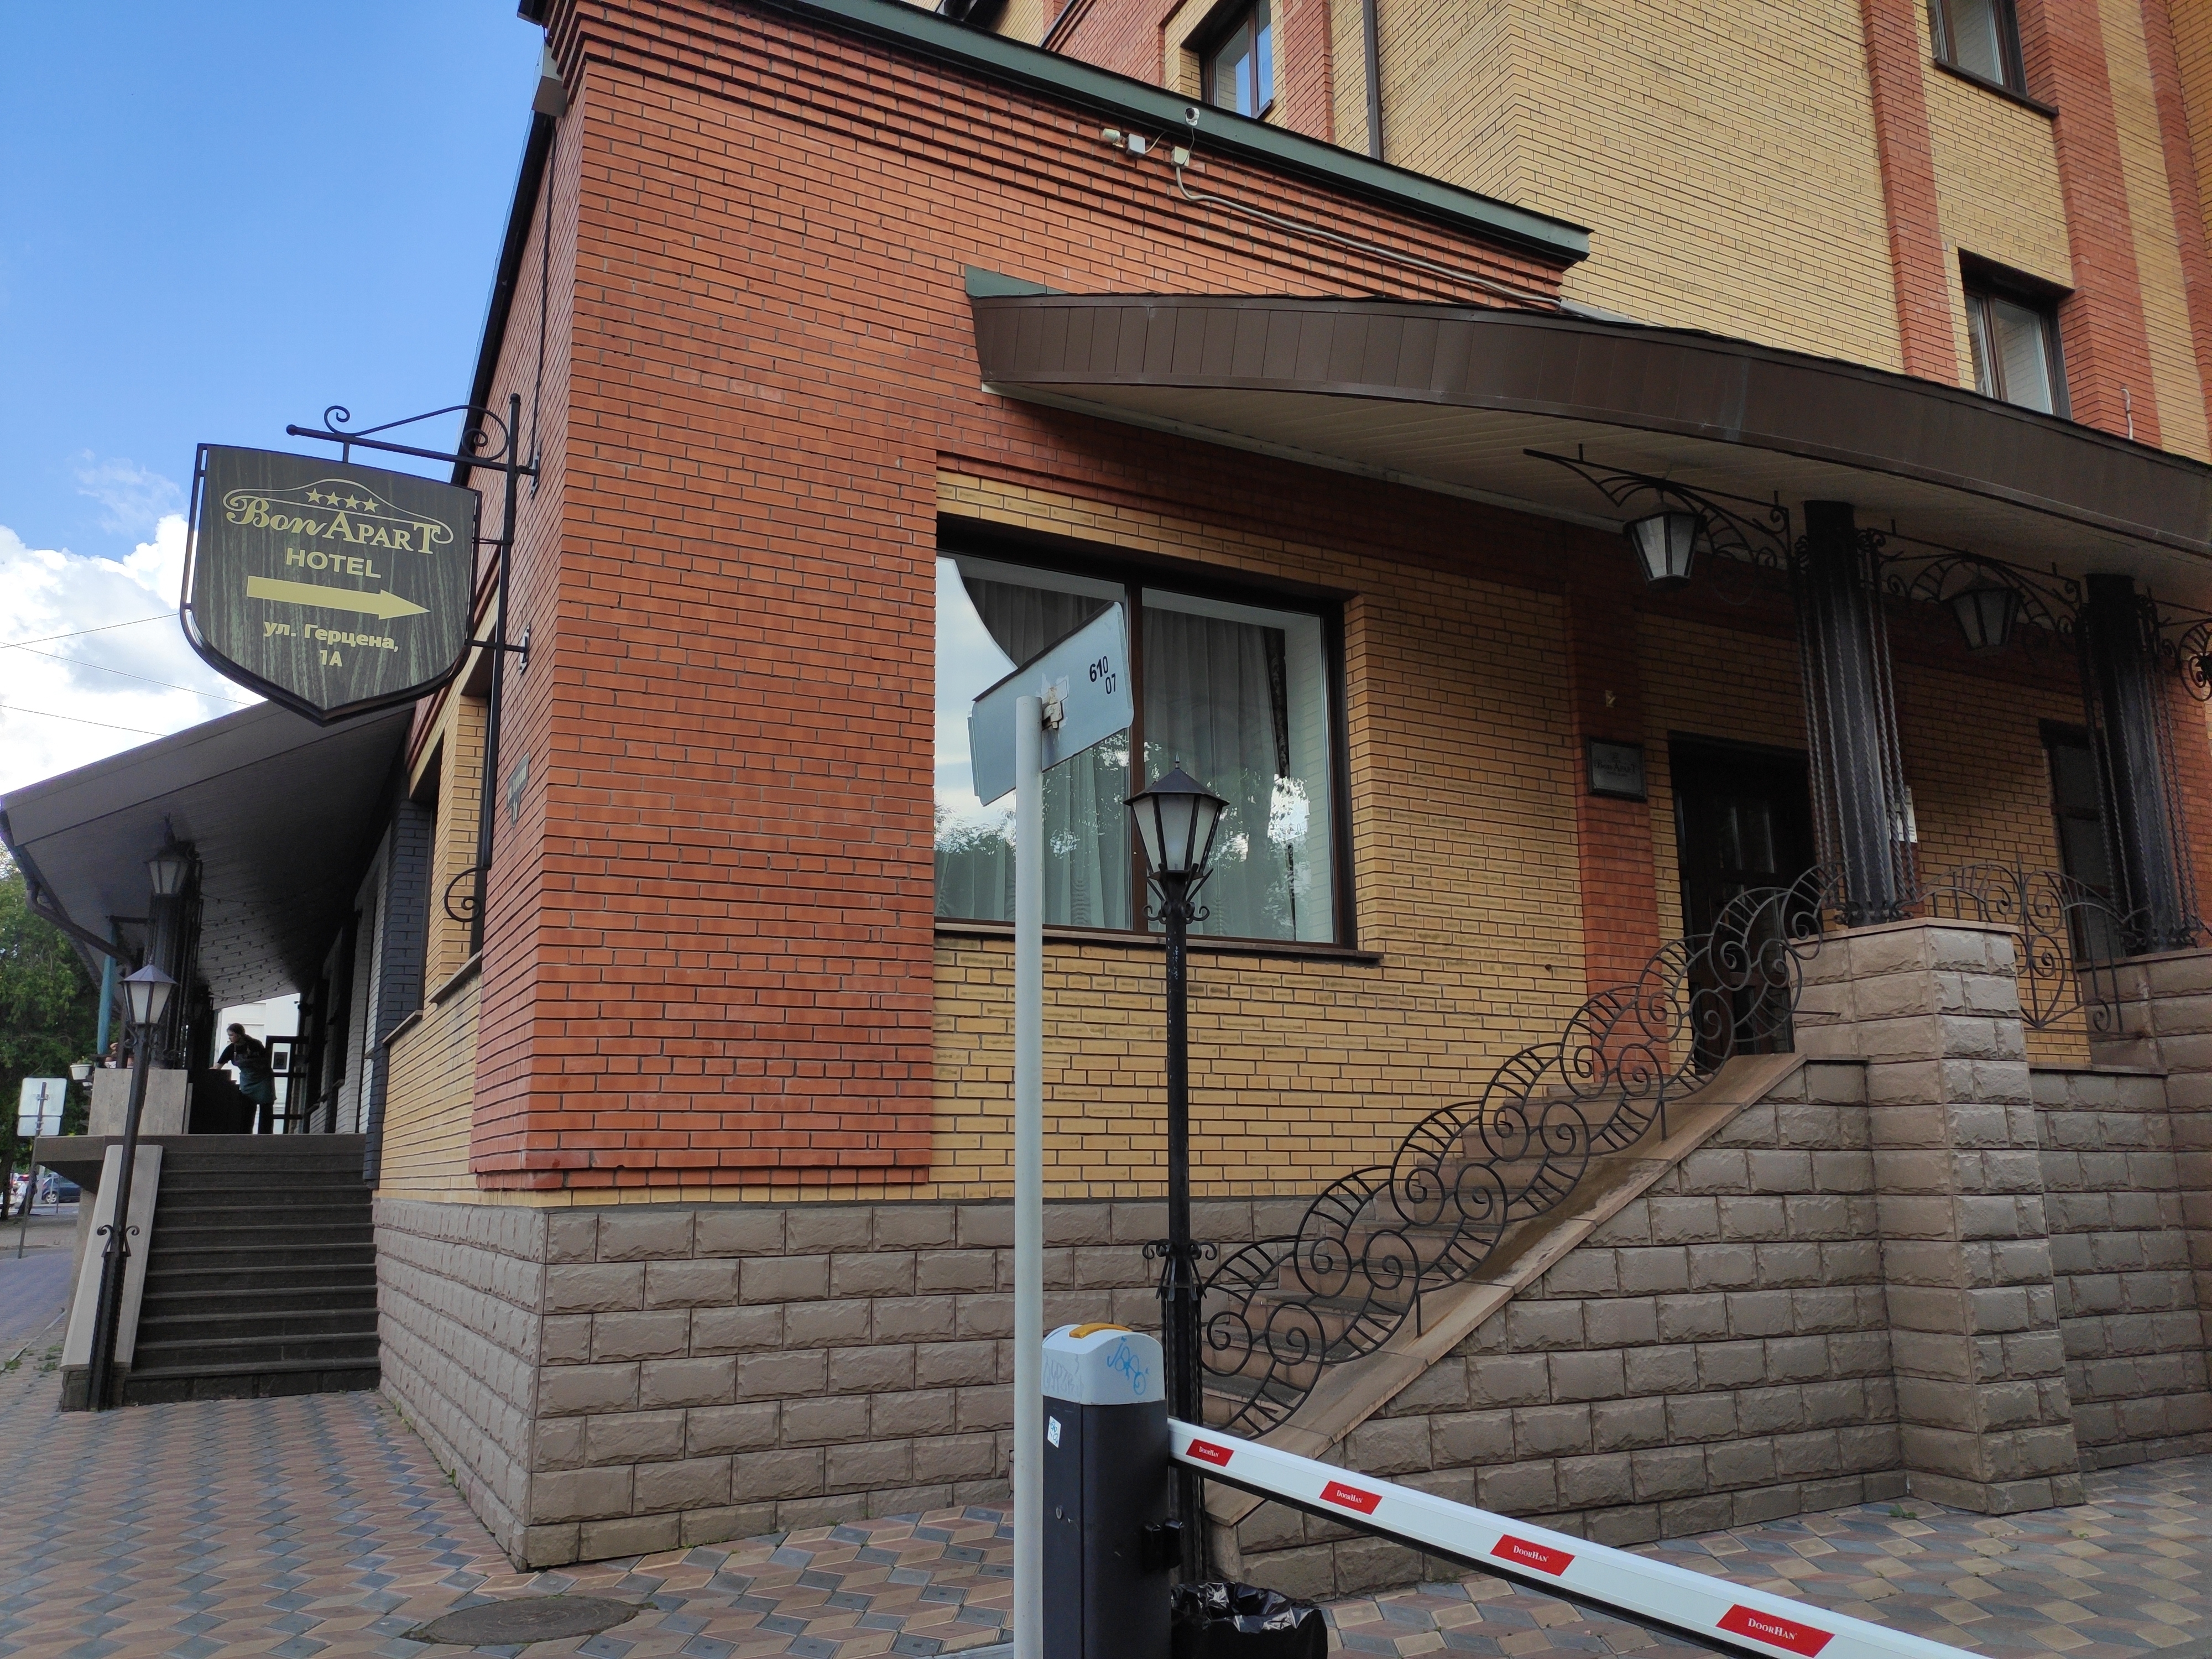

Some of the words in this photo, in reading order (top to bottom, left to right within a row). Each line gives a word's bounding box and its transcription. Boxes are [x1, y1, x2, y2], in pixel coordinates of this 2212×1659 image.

[285, 547, 382, 579] HOTEL
[264, 621, 297, 637] ул.
[304, 623, 399, 653] Герцена,
[319, 649, 343, 667] 1А
[1089, 655, 1109, 682] 610
[1105, 672, 1117, 695] 07
